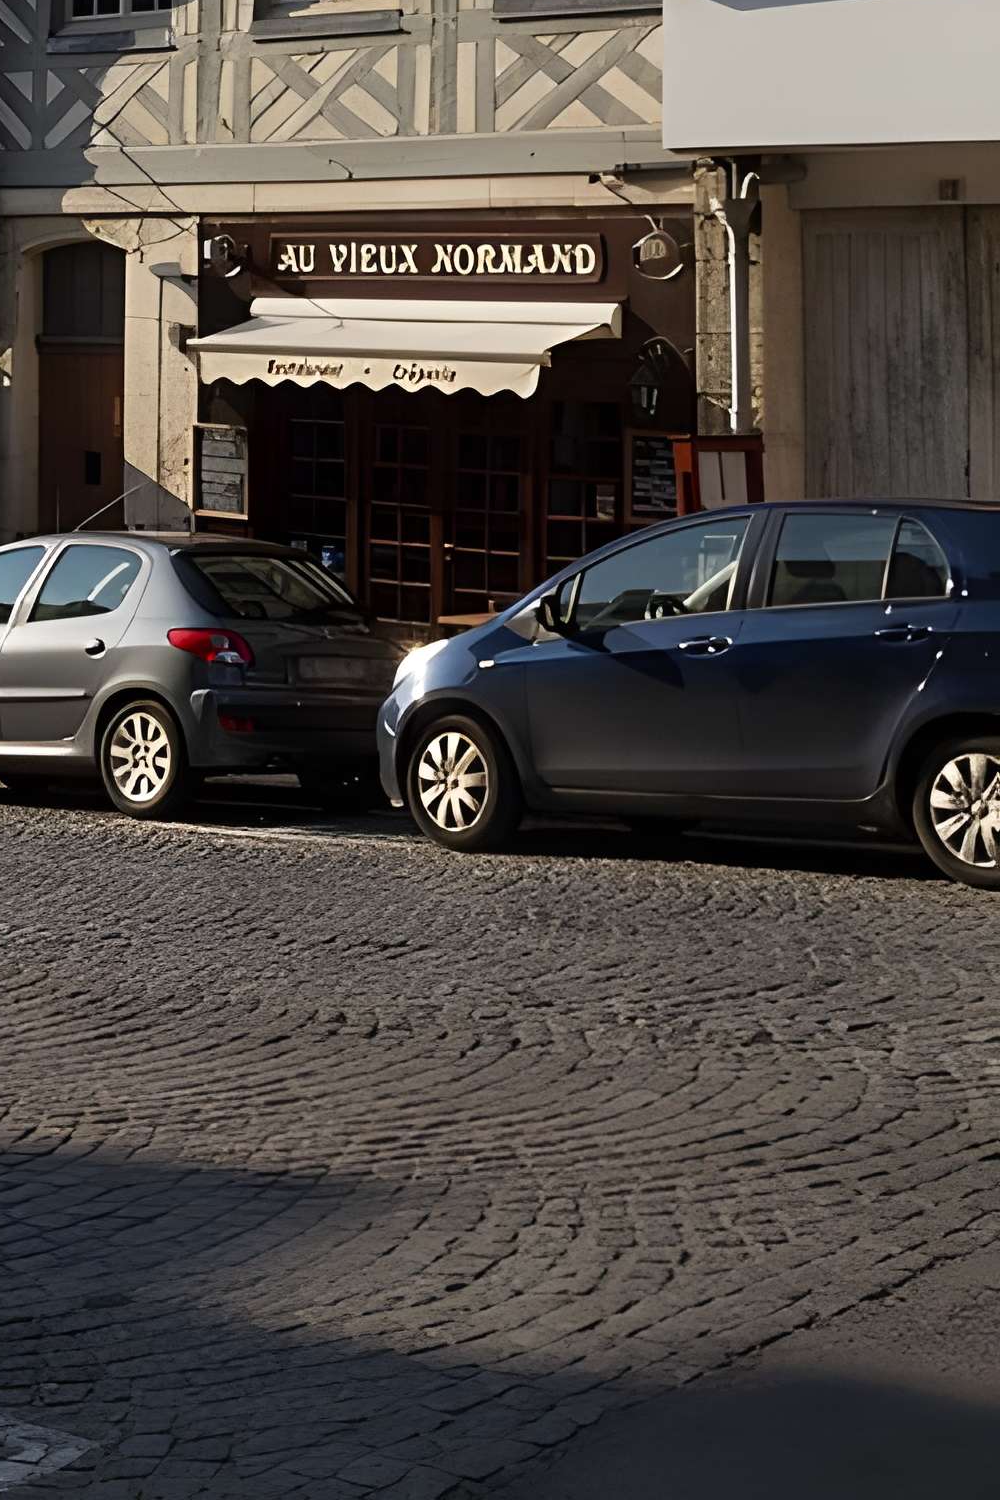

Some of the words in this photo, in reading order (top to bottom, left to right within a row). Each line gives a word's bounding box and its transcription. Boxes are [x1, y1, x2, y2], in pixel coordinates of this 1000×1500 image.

[277, 244, 315, 273] AU
[328, 242, 418, 274] VIEUX
[431, 243, 596, 275] NORMAND
